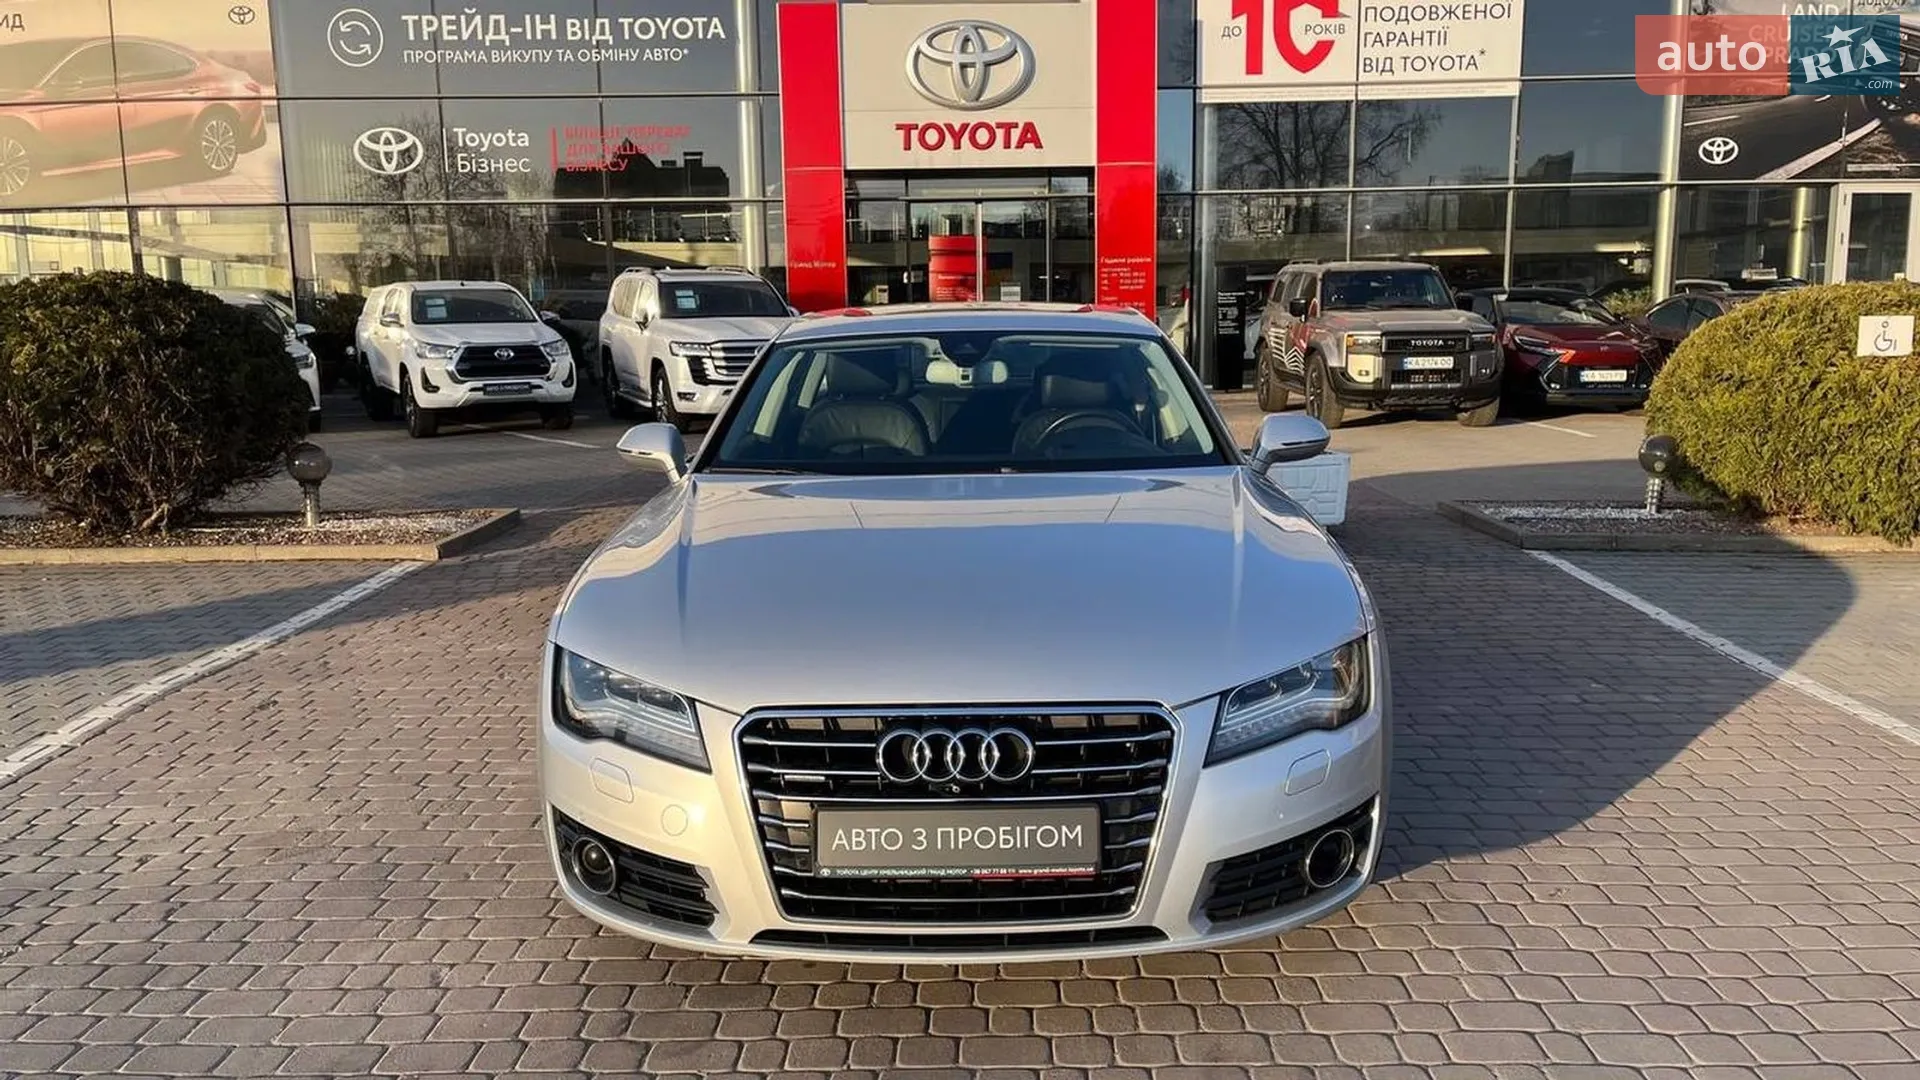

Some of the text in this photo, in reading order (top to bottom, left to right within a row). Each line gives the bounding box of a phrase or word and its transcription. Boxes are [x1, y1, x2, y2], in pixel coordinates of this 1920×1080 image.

[401, 8, 726, 46] ТРЕЙД-ІН ВІД TOYOTA
[1221, 25, 1242, 39] ДО
[1304, 23, 1346, 36] РОКІВ
[1363, 26, 1450, 48] ГАРАНТІЇ
[403, 50, 488, 64] ПРОГРАМА
[491, 50, 553, 63] ВИКУПУ
[556, 49, 574, 62] ТА
[577, 48, 639, 62] ОБМІНУ
[1362, 56, 1395, 76] ВІД
[453, 128, 530, 152] Toyota
[895, 121, 1044, 151] TOYOTA
[457, 153, 531, 173] Бізнес
[1411, 339, 1444, 347] TOYOTA
[831, 825, 1083, 851] АВТО З ПРОБІГОМ
